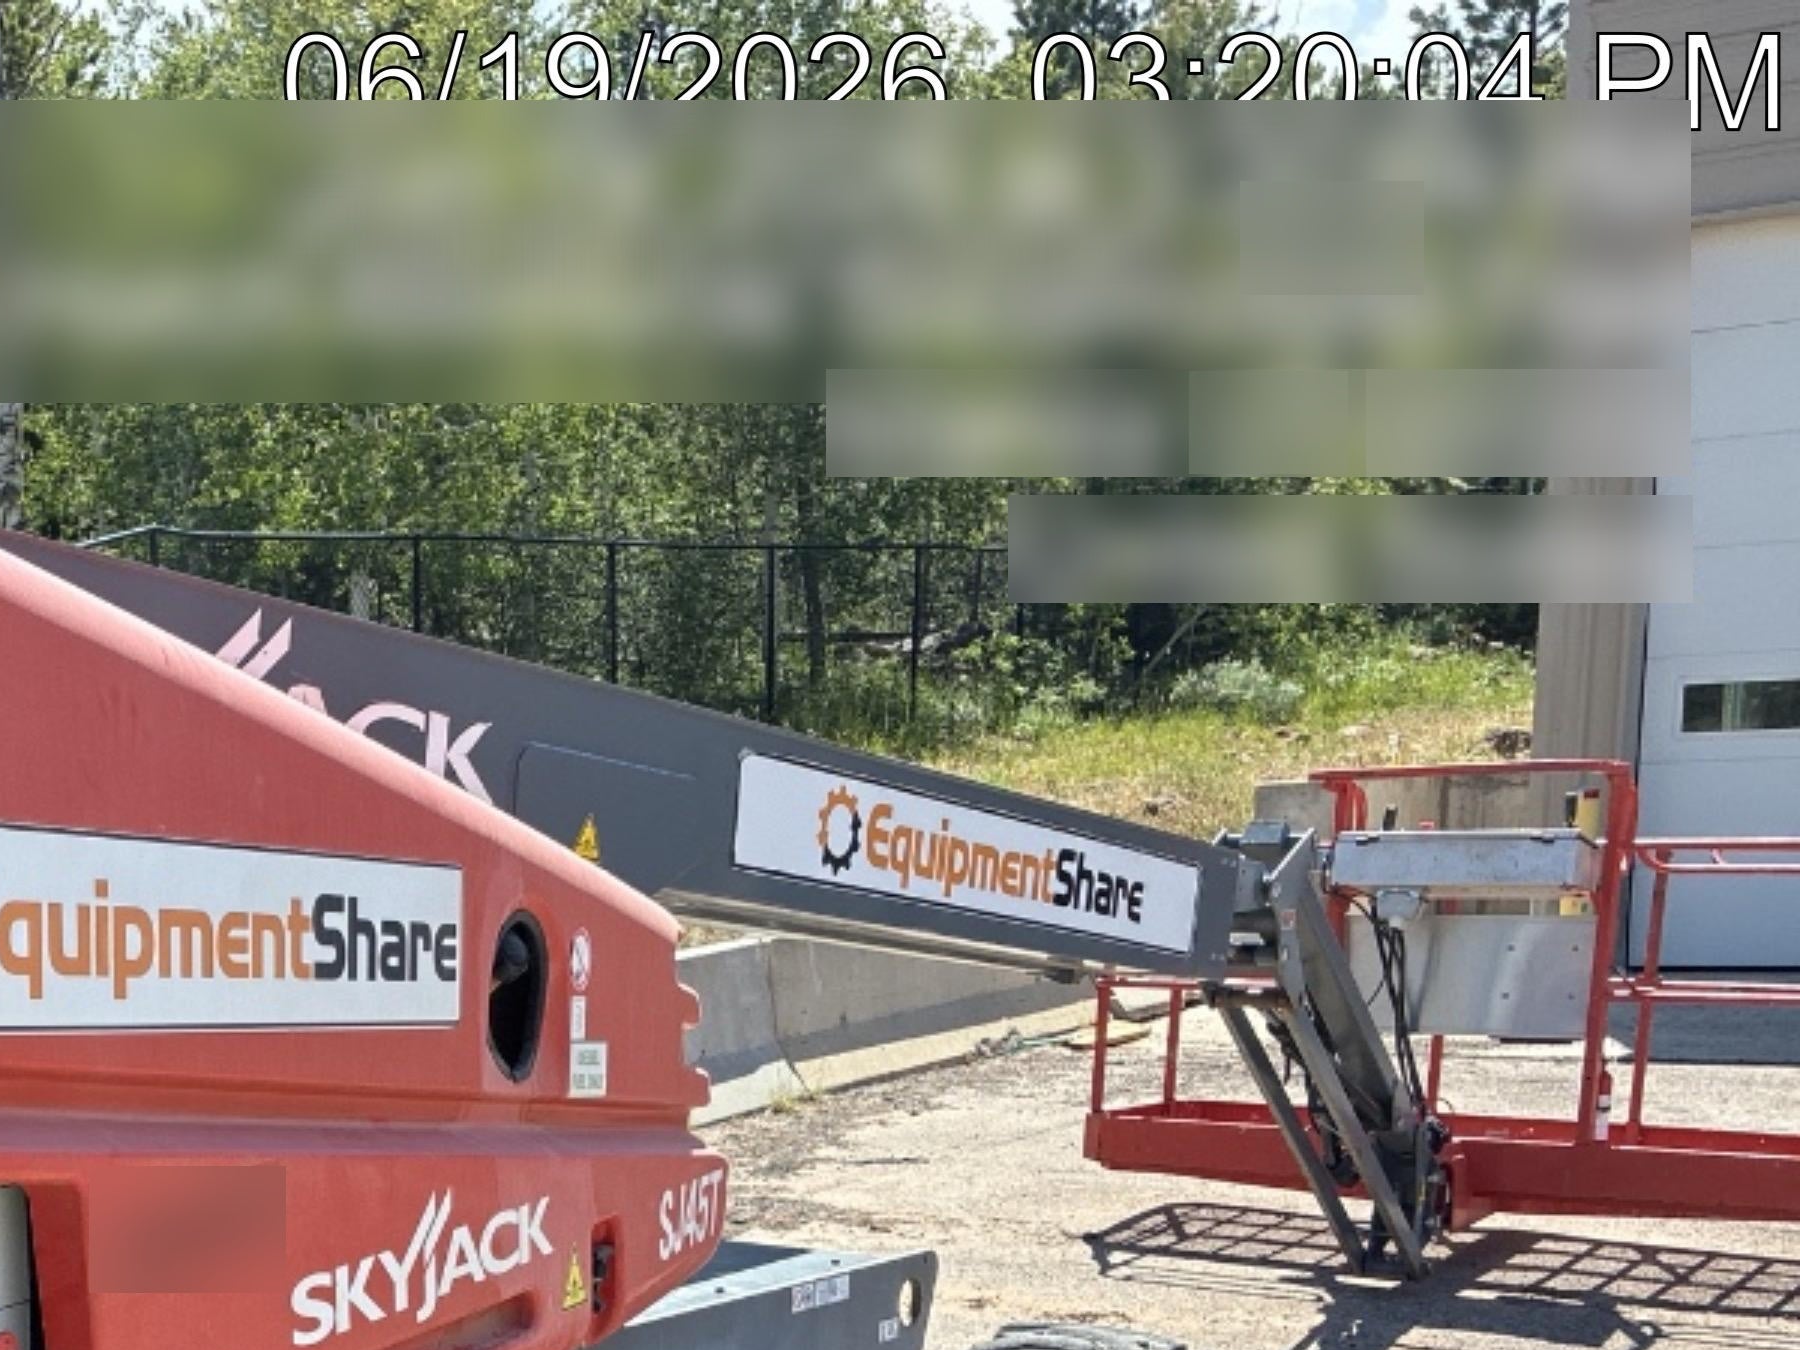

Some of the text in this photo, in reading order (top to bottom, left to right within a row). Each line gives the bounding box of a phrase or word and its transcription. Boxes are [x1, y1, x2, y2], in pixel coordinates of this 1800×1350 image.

[865, 803, 1144, 924] EquipmentShare
[289, 1186, 555, 1347] SKYJACK
[658, 1167, 725, 1262] SJ45T
